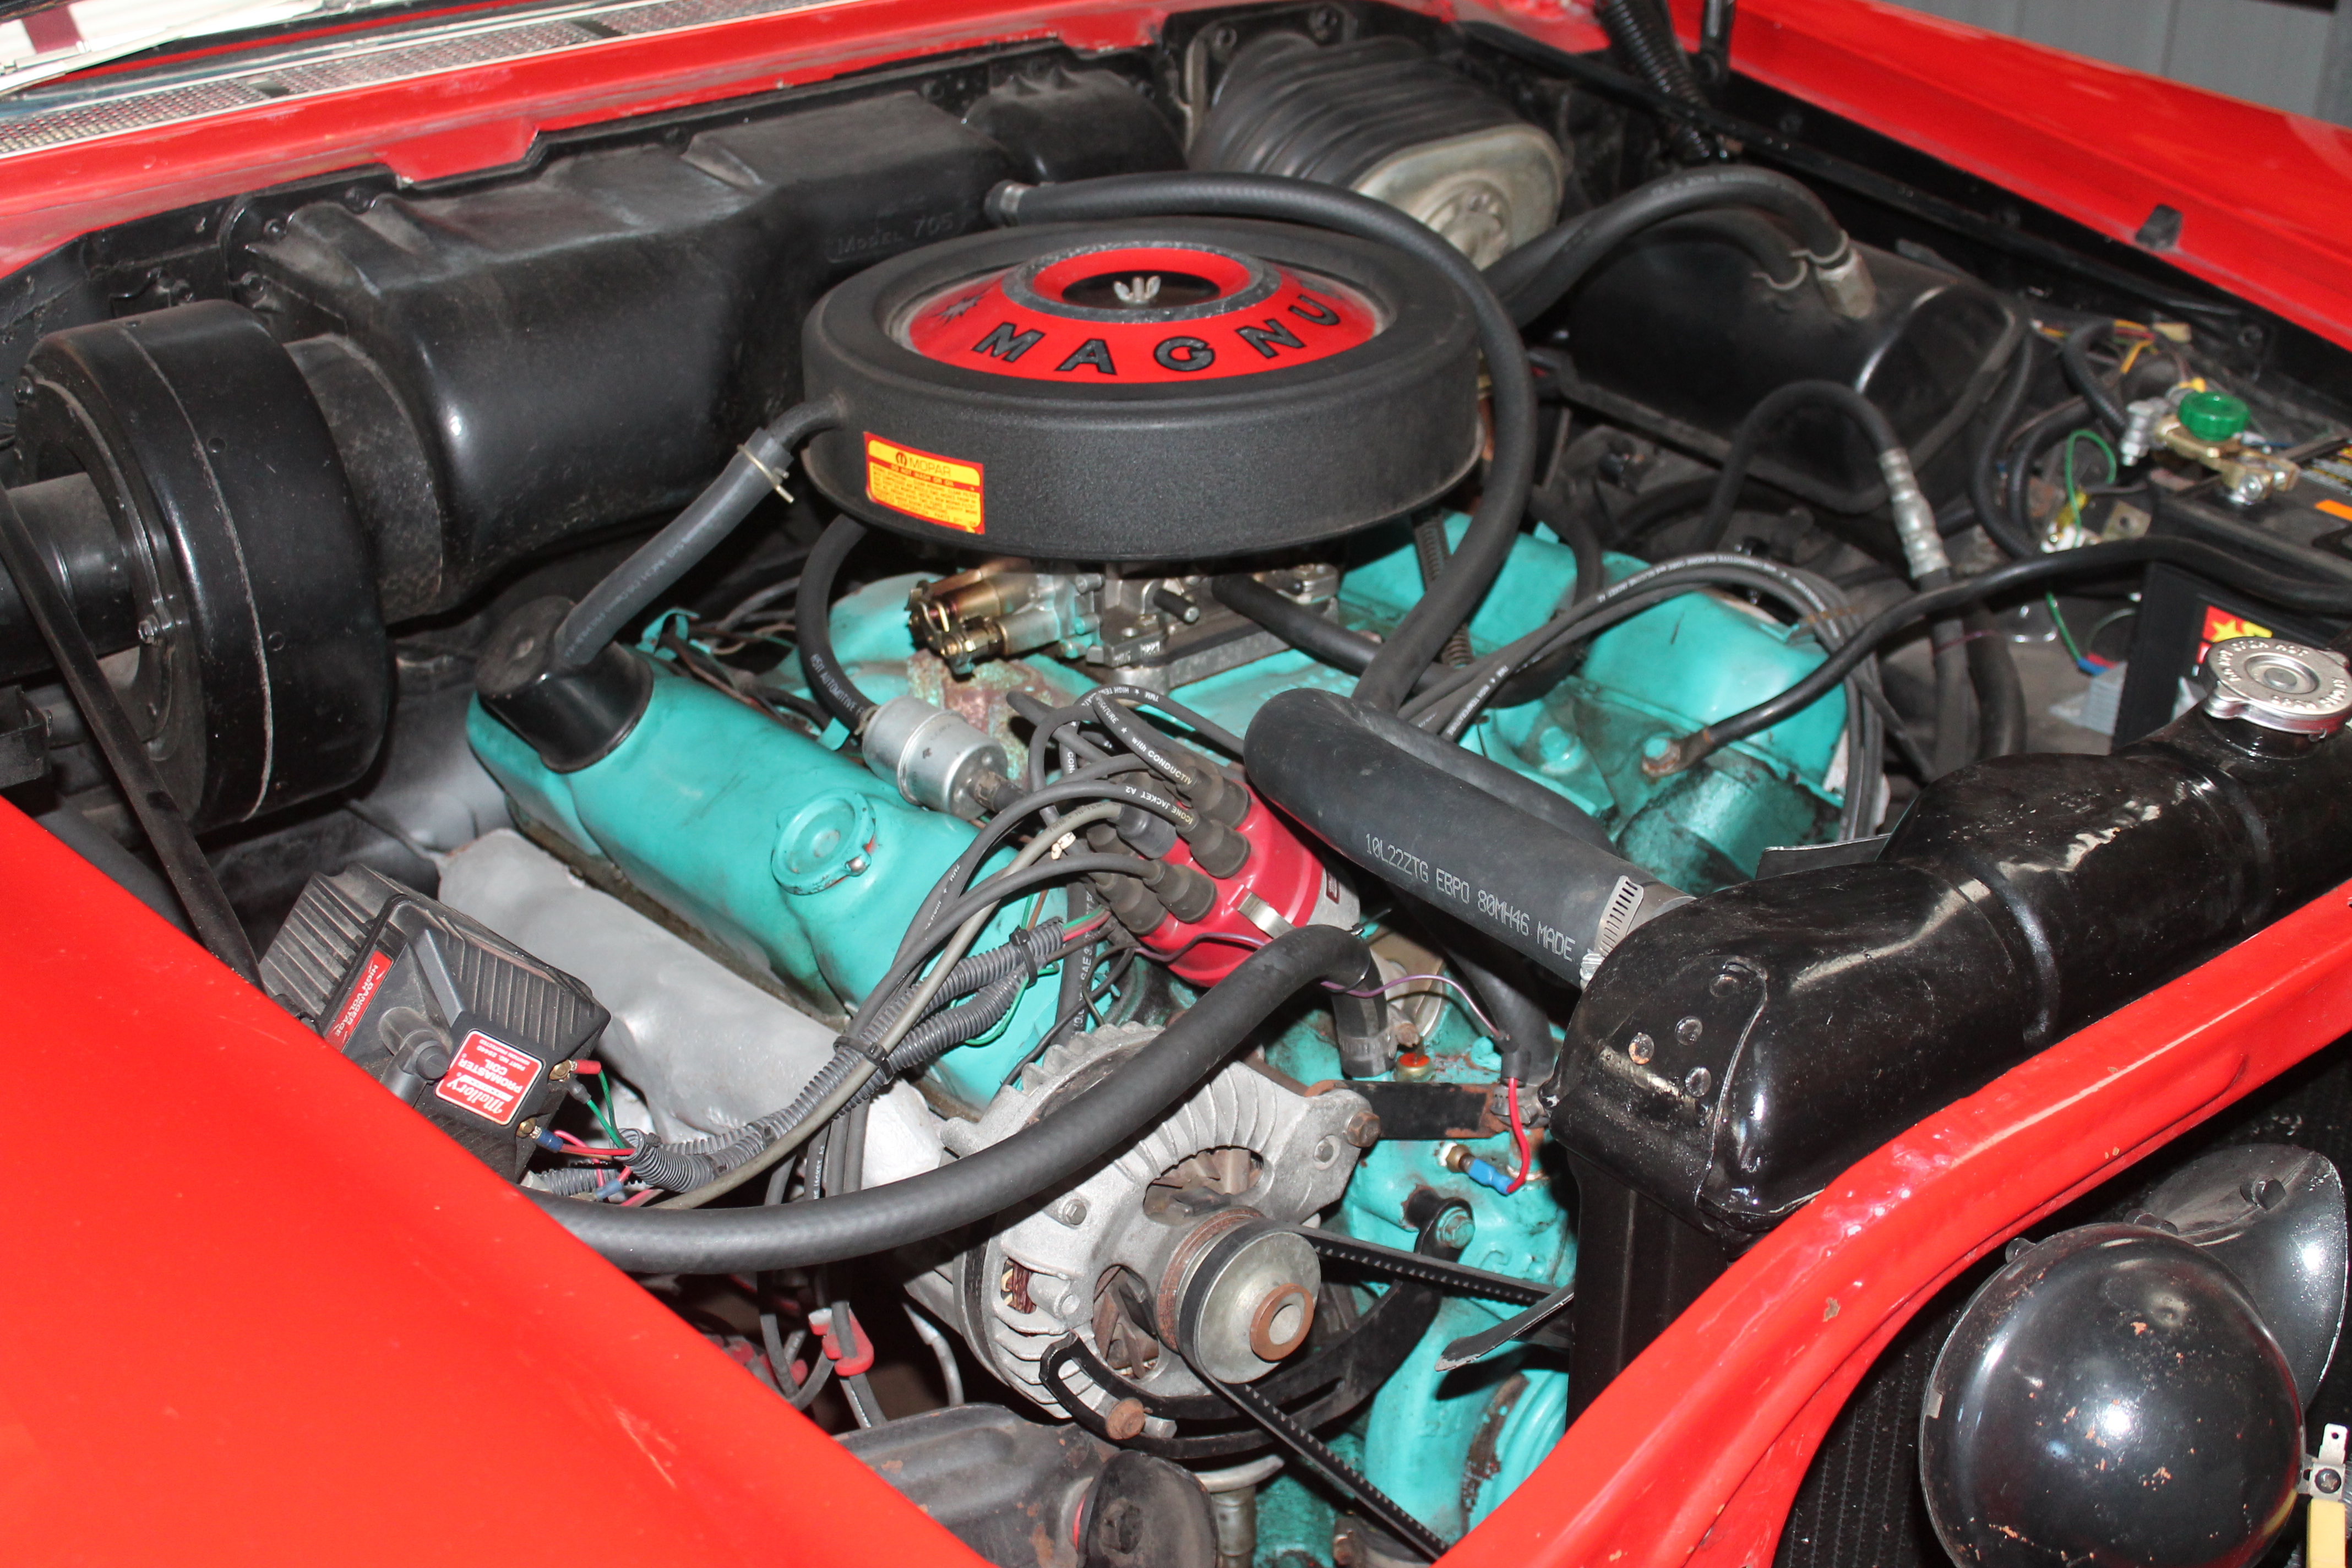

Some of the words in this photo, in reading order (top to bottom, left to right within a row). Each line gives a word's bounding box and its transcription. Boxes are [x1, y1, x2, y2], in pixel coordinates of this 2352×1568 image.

[972, 288, 1343, 376] MAGNU
[901, 466, 912, 476] NOT
[914, 471, 931, 481] WASH
[945, 478, 954, 487] OIL
[910, 457, 951, 478] MOPAR
[820, 671, 857, 712] AUTOMOTIVE
[1113, 685, 1131, 695] HIGH
[1131, 737, 1147, 752] with
[1125, 786, 1137, 794] A2
[1140, 791, 1171, 810] JACKET
[1537, 921, 1576, 962] MADE
[362, 965, 379, 991] HIGH
[335, 993, 363, 1036] VOLTAGE
[348, 983, 374, 1026] DANGER
[479, 1039, 508, 1054] PROTECTED
[484, 1059, 508, 1076] COIL
[508, 1050, 531, 1066] IGNITION
[509, 1061, 526, 1071] PART
[458, 1058, 523, 1094] PROMASTER
[447, 1078, 505, 1114] Mallory
